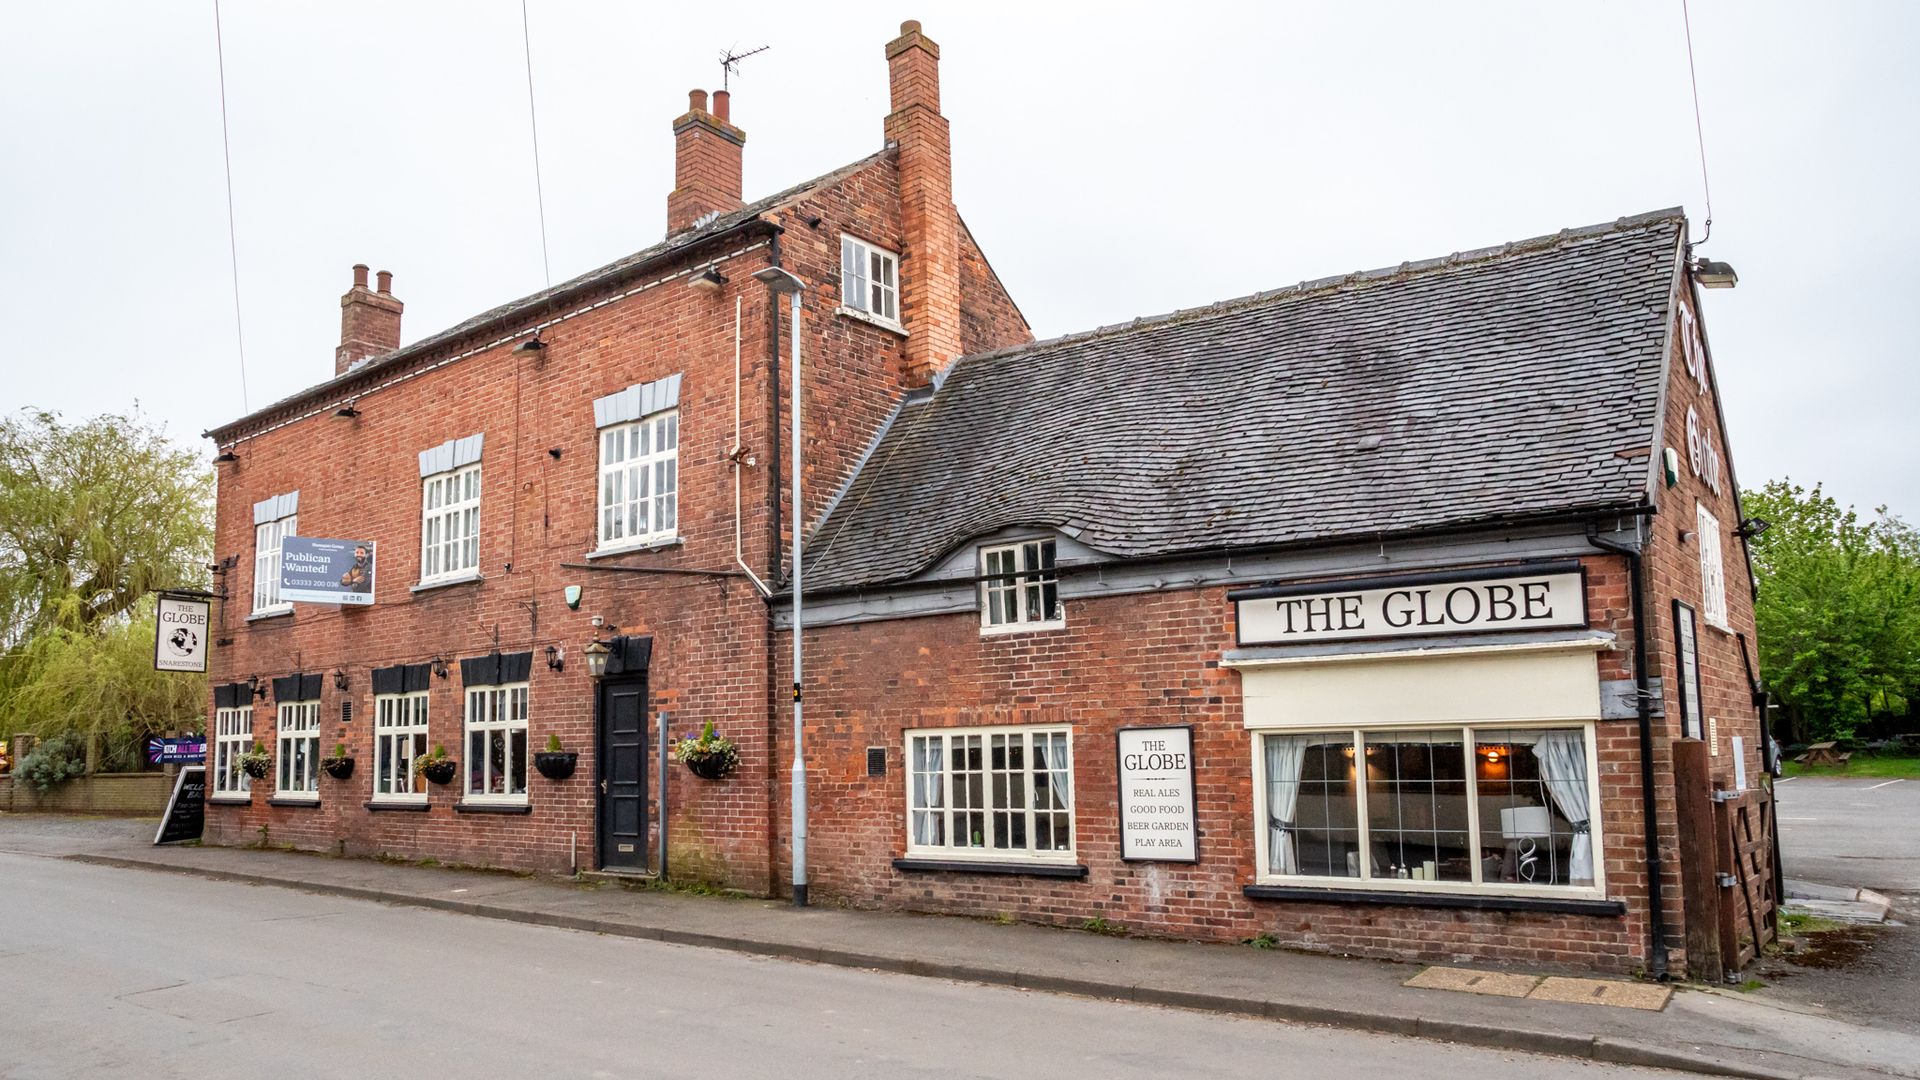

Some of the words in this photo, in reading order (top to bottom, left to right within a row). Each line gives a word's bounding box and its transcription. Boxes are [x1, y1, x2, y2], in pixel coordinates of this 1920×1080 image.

[285, 552, 331, 563] Publican
[285, 562, 328, 574] Wanted!
[1276, 594, 1365, 634] THE
[1381, 581, 1553, 628] GLOBE
[162, 612, 205, 624] GLOBE
[1142, 740, 1166, 752] THE
[1124, 754, 1186, 770] GLOBE
[1134, 789, 1156, 797] REAL
[1158, 789, 1180, 797] ALES
[1130, 806, 1156, 814] GOOD
[1159, 806, 1184, 814] FOOD
[1127, 822, 1150, 830] BEER
[1152, 822, 1188, 830] GARDEN
[1135, 838, 1156, 846] PLAY
[1158, 839, 1182, 847] AREA
